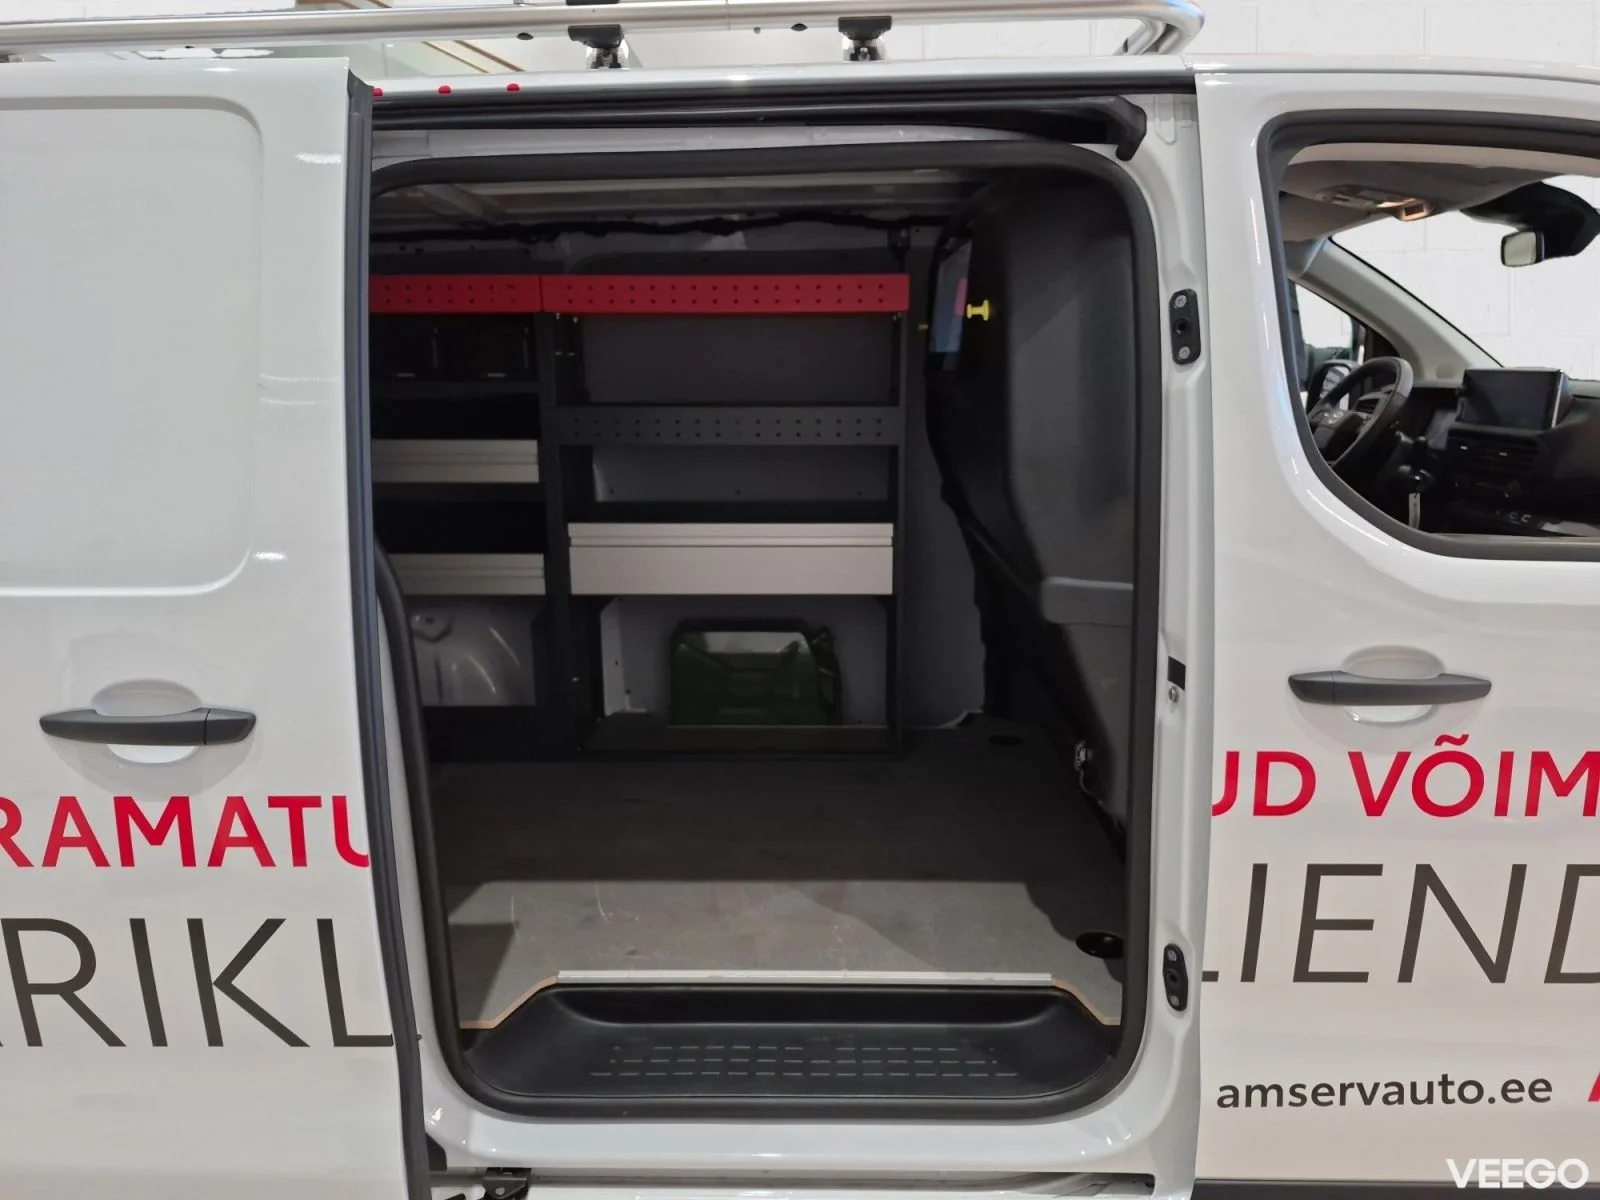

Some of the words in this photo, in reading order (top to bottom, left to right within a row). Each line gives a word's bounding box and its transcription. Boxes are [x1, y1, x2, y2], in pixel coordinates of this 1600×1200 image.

[1347, 733, 1600, 818] VÕIM
[0, 917, 393, 1048] RIKL
[1216, 1073, 1553, 1109] amservauto.ee
